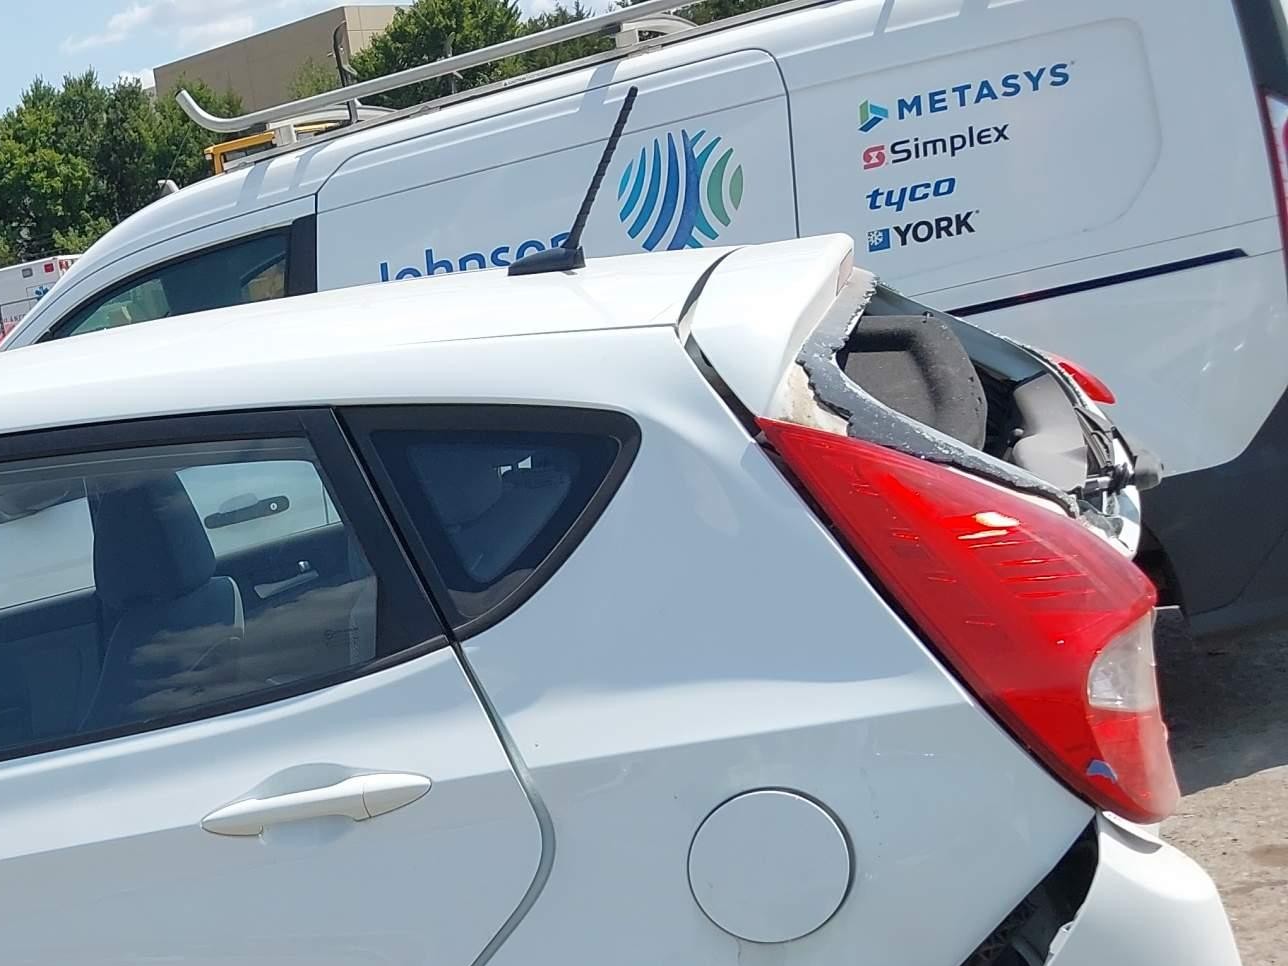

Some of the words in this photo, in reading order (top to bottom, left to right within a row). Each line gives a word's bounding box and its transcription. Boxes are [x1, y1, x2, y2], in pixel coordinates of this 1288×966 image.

[897, 63, 1070, 120] METASYS
[890, 123, 1010, 164] Simplex
[866, 177, 956, 212] tyco
[893, 211, 975, 247] YORK
